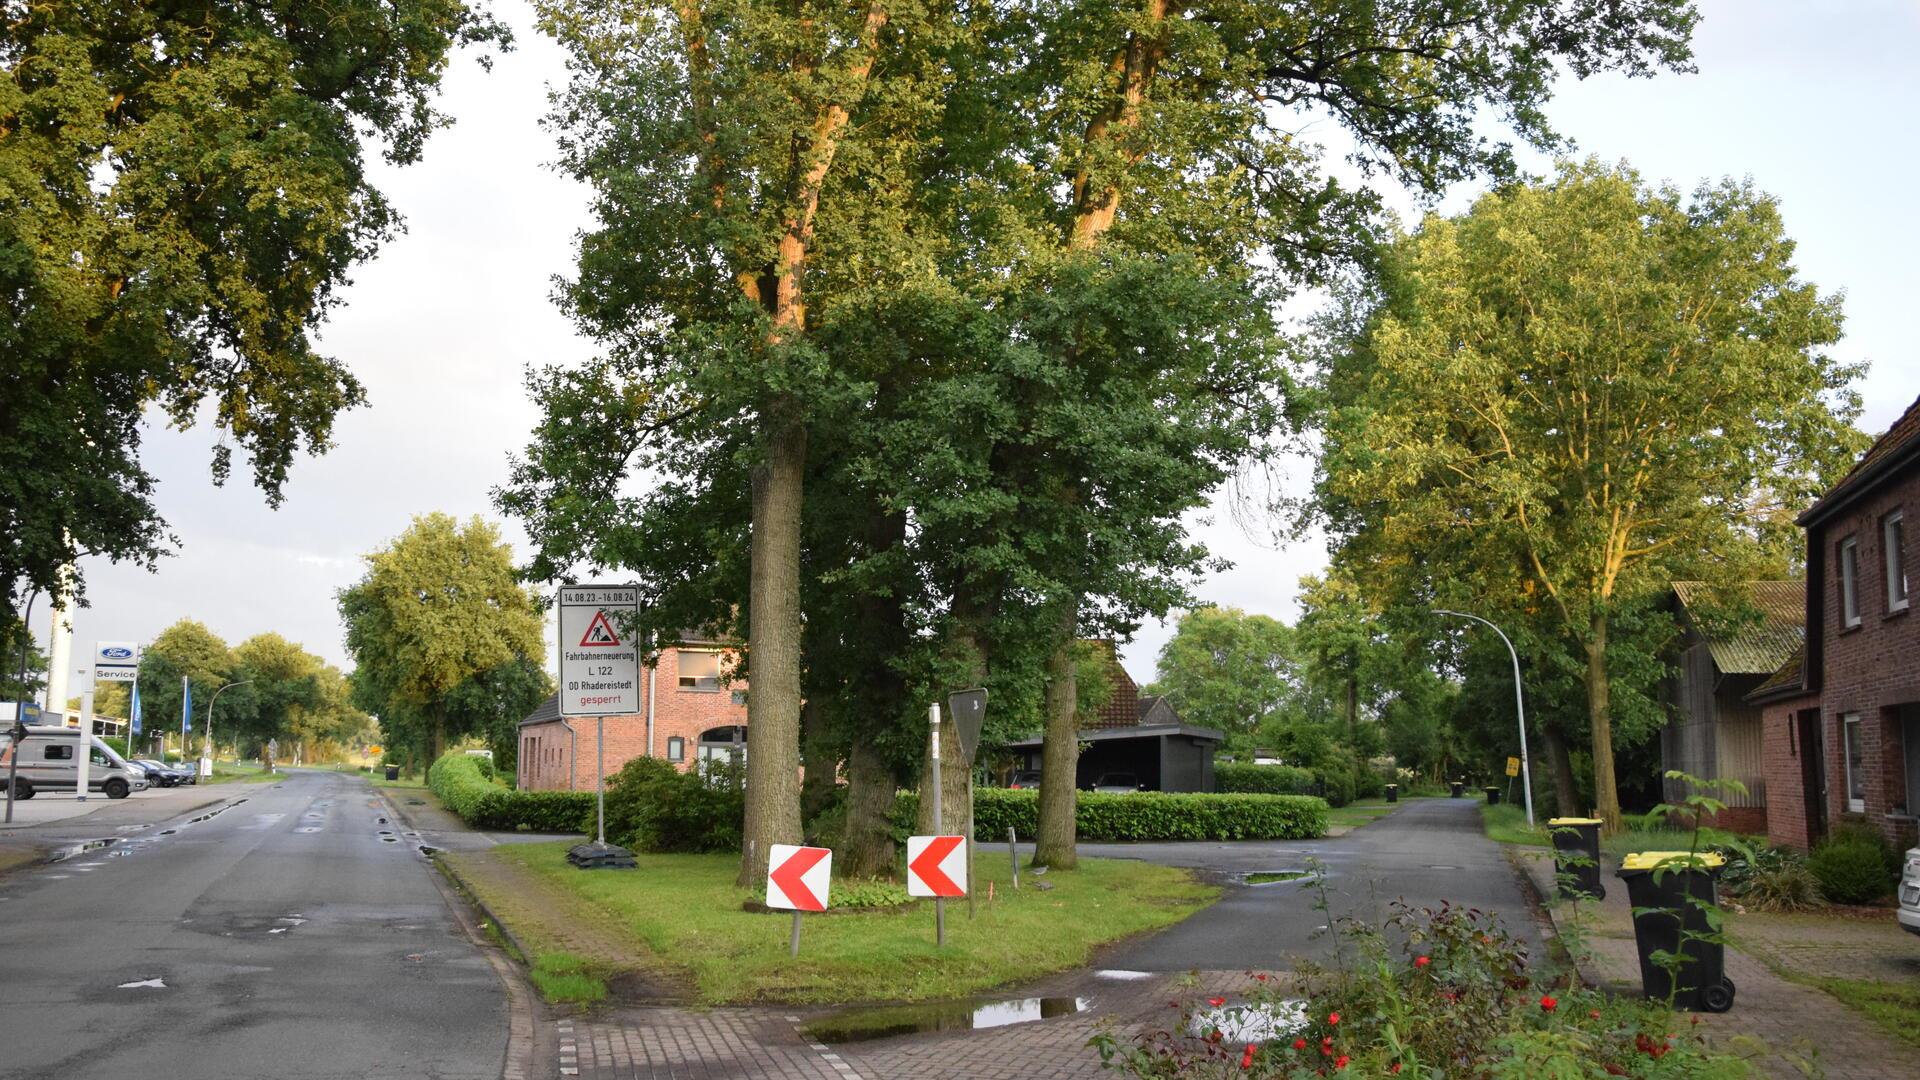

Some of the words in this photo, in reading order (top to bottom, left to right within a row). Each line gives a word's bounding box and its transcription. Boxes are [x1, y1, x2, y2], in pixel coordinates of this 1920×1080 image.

[106, 647, 127, 657] Ford
[565, 652, 635, 662] Fahrbahnerneuerung
[96, 670, 136, 678] Service
[588, 666, 595, 676] L
[598, 666, 613, 676] 122
[581, 681, 632, 690] Rhadereistedt
[580, 696, 622, 706] gesperrt
